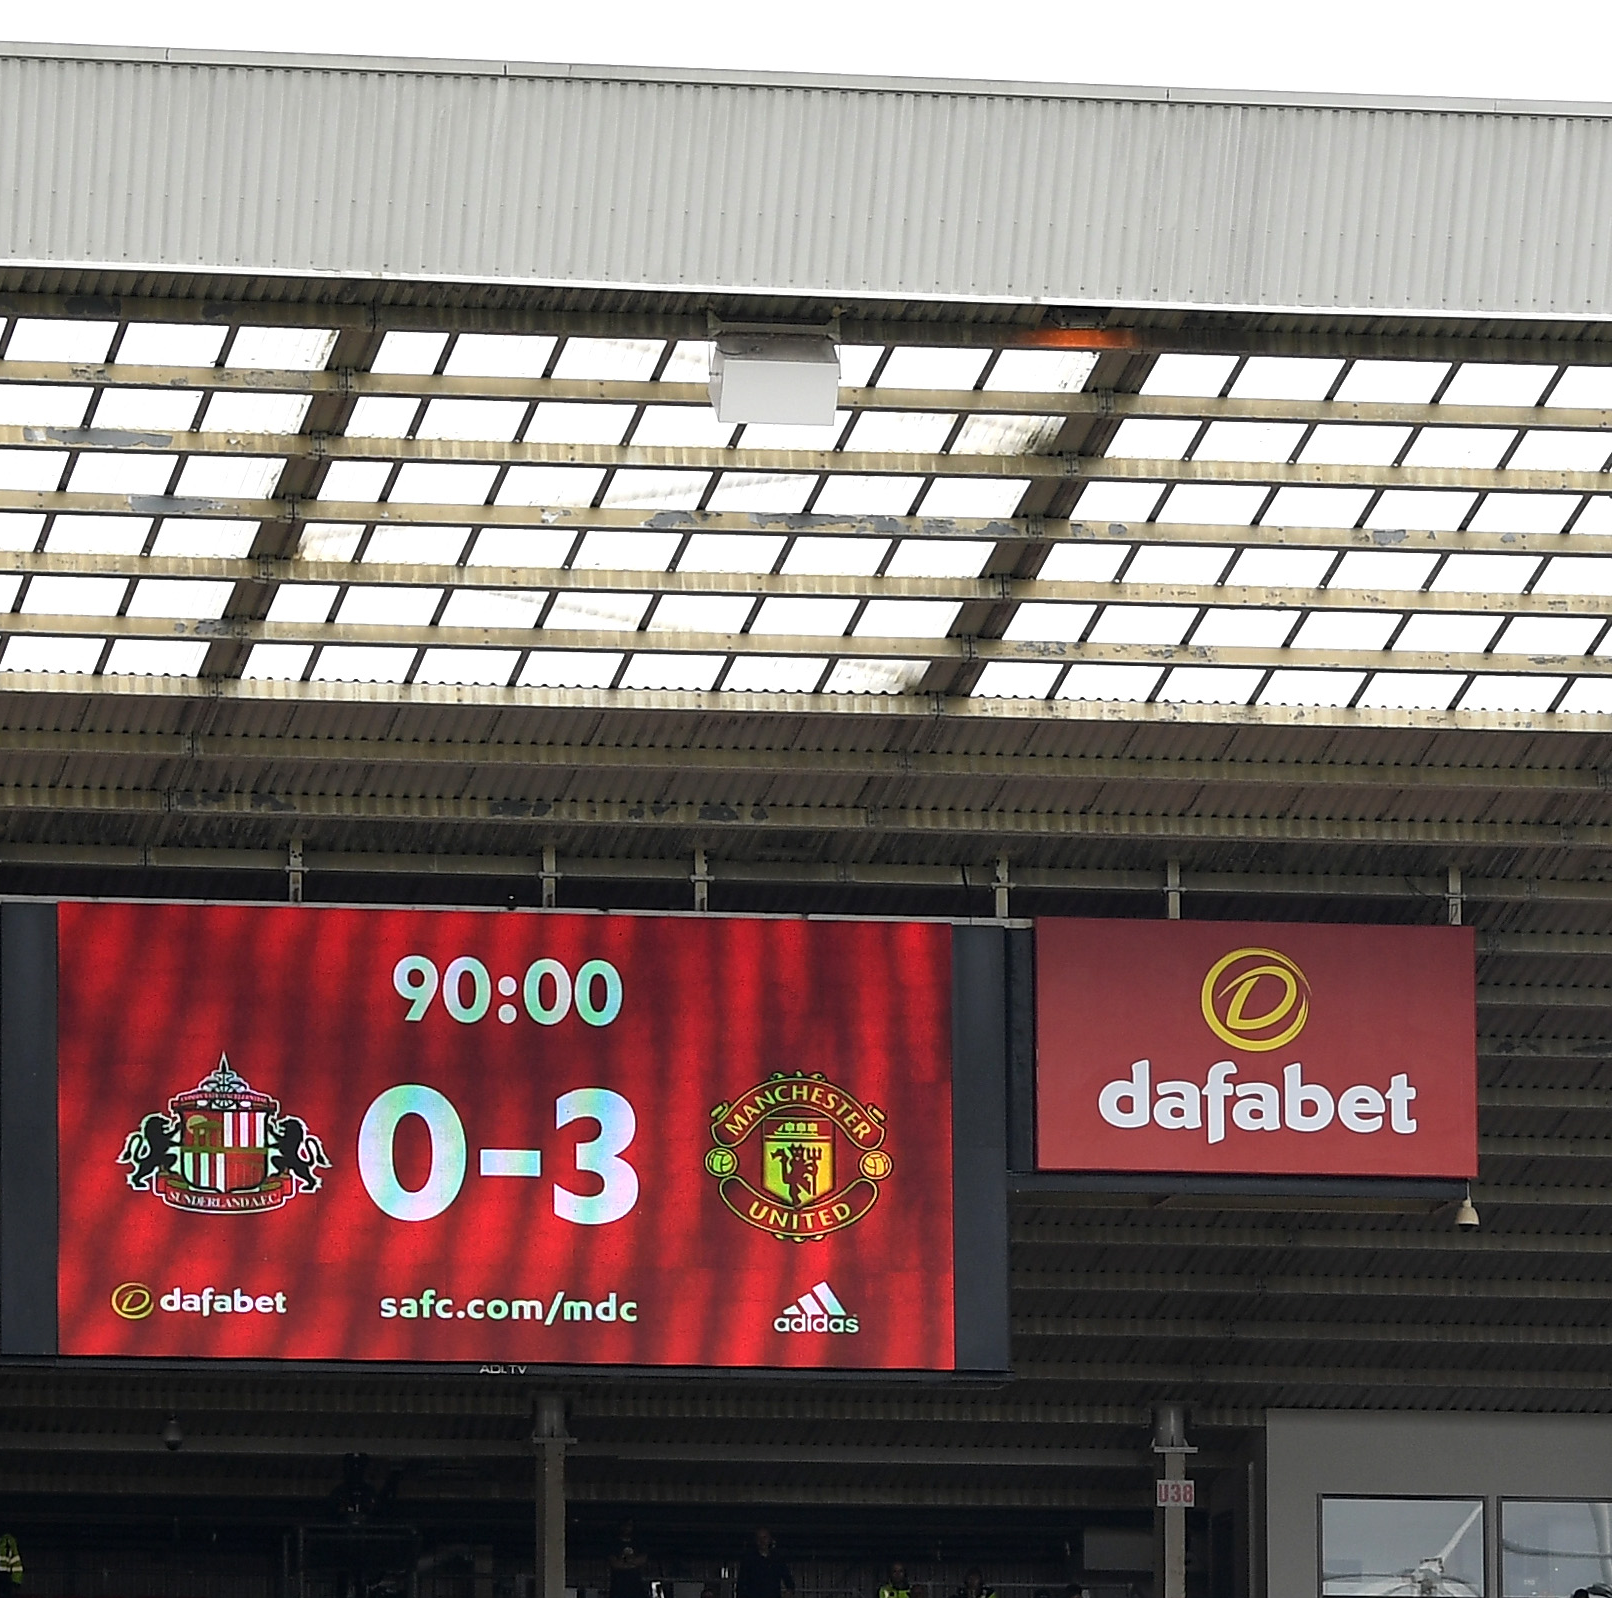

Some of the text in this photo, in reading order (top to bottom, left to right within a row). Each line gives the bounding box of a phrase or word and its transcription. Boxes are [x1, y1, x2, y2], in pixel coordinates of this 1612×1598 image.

[393, 955, 624, 1027] 90:00
[724, 1085, 872, 1141] MANCHESTER
[1098, 1059, 1417, 1144] dafabet
[168, 1191, 250, 1209] SUNDERLAND
[749, 1201, 851, 1230] UNITED
[160, 1287, 287, 1317] dafabet
[380, 1289, 638, 1326] safc.com/mdc
[774, 1313, 860, 1333] adidas
[1158, 1483, 1194, 1503] U38
